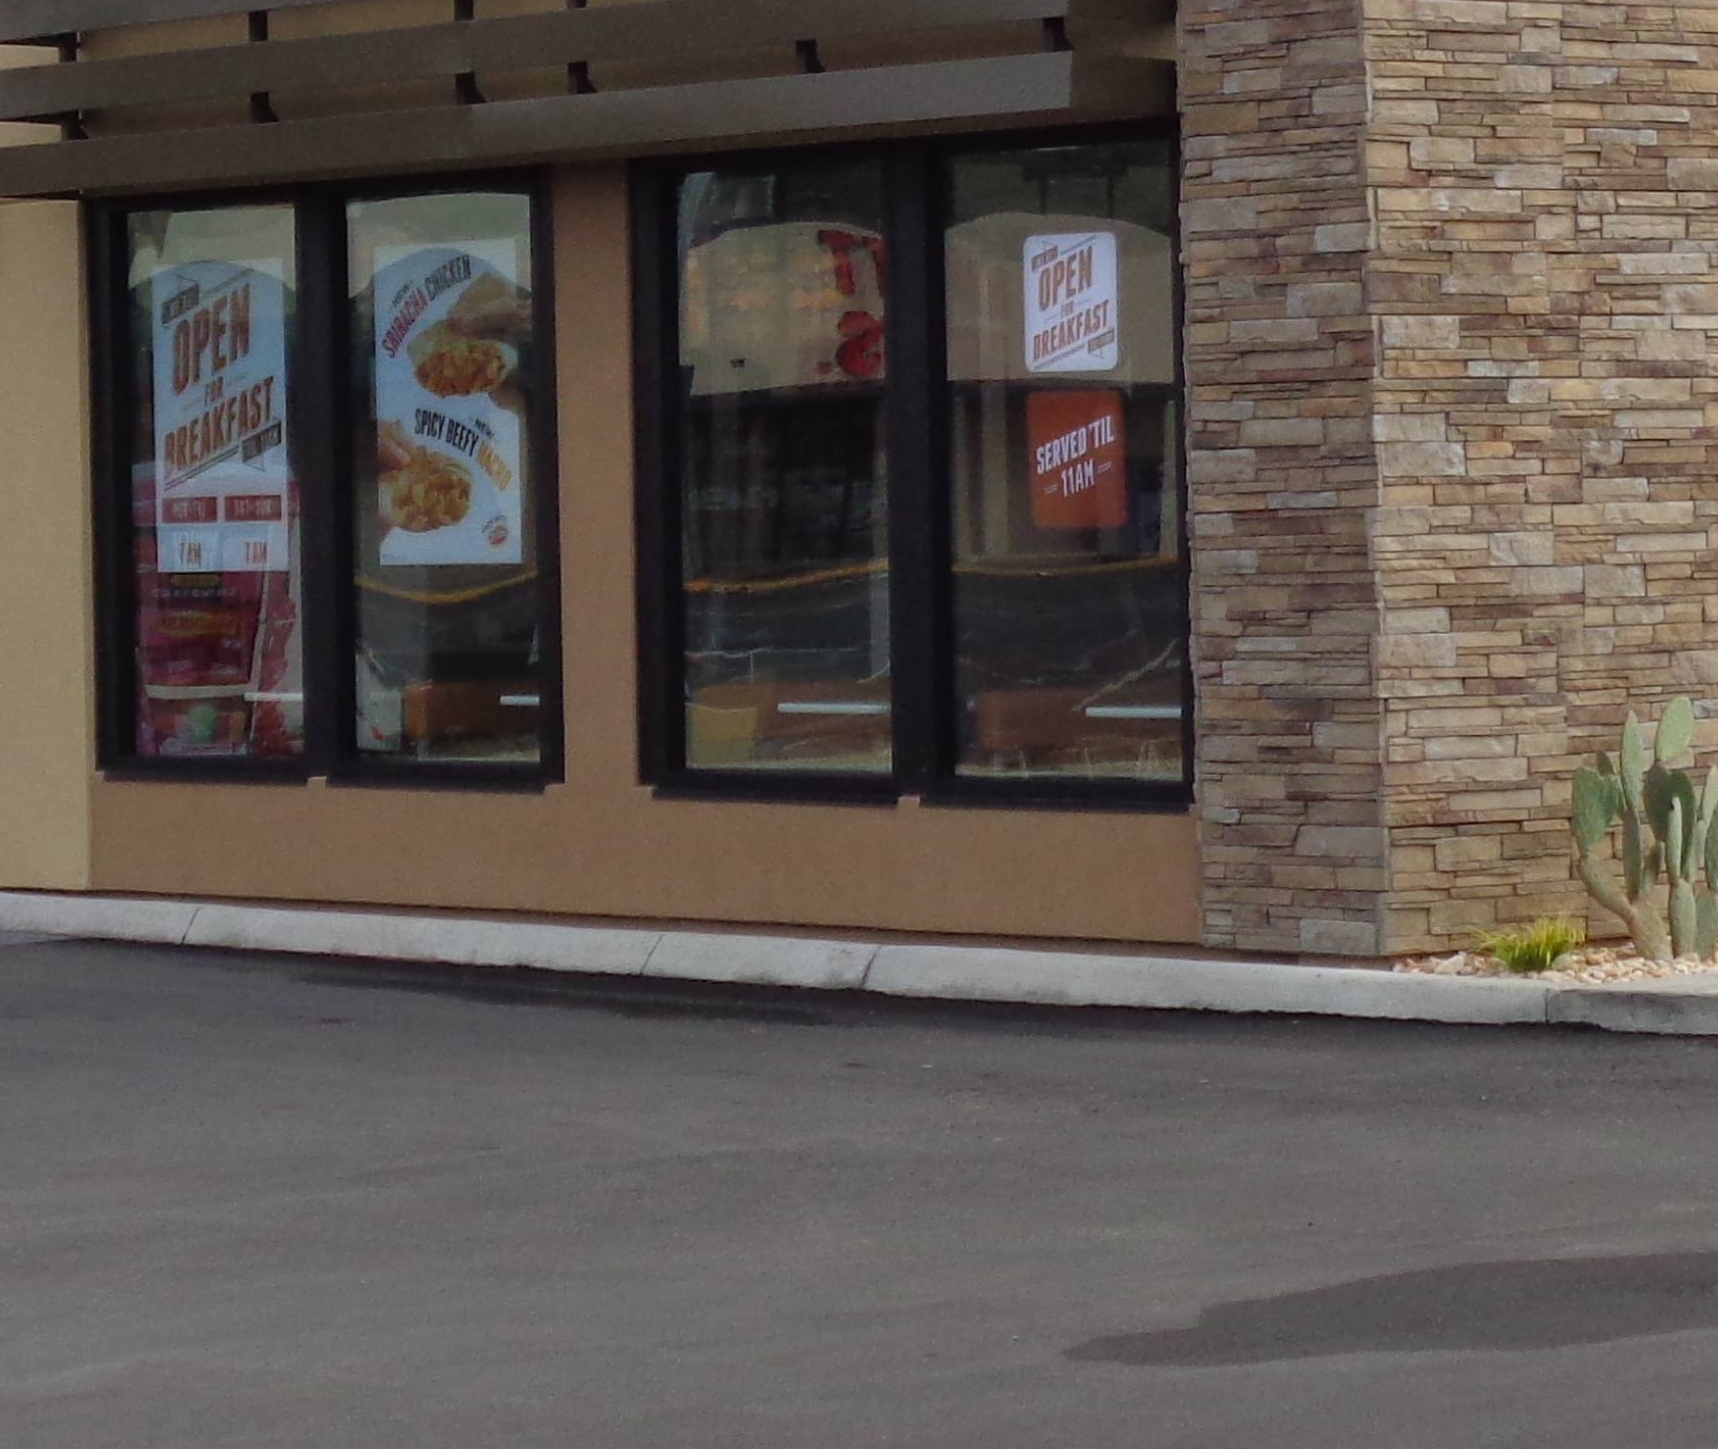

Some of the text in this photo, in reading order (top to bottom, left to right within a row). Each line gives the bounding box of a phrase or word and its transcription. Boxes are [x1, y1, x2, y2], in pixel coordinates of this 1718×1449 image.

[424, 254, 471, 301] CHICKEN
[1039, 245, 1093, 311] OPEN
[173, 282, 251, 396] OPEN
[1033, 299, 1109, 362] BREAKFAST
[205, 376, 224, 406] FOR
[164, 375, 274, 479] BREAKFAST
[414, 408, 446, 440] SPICY
[445, 418, 480, 458] BEEFY
[1036, 415, 1116, 475] SERVED 'TIL
[1061, 458, 1095, 497] 11AM
